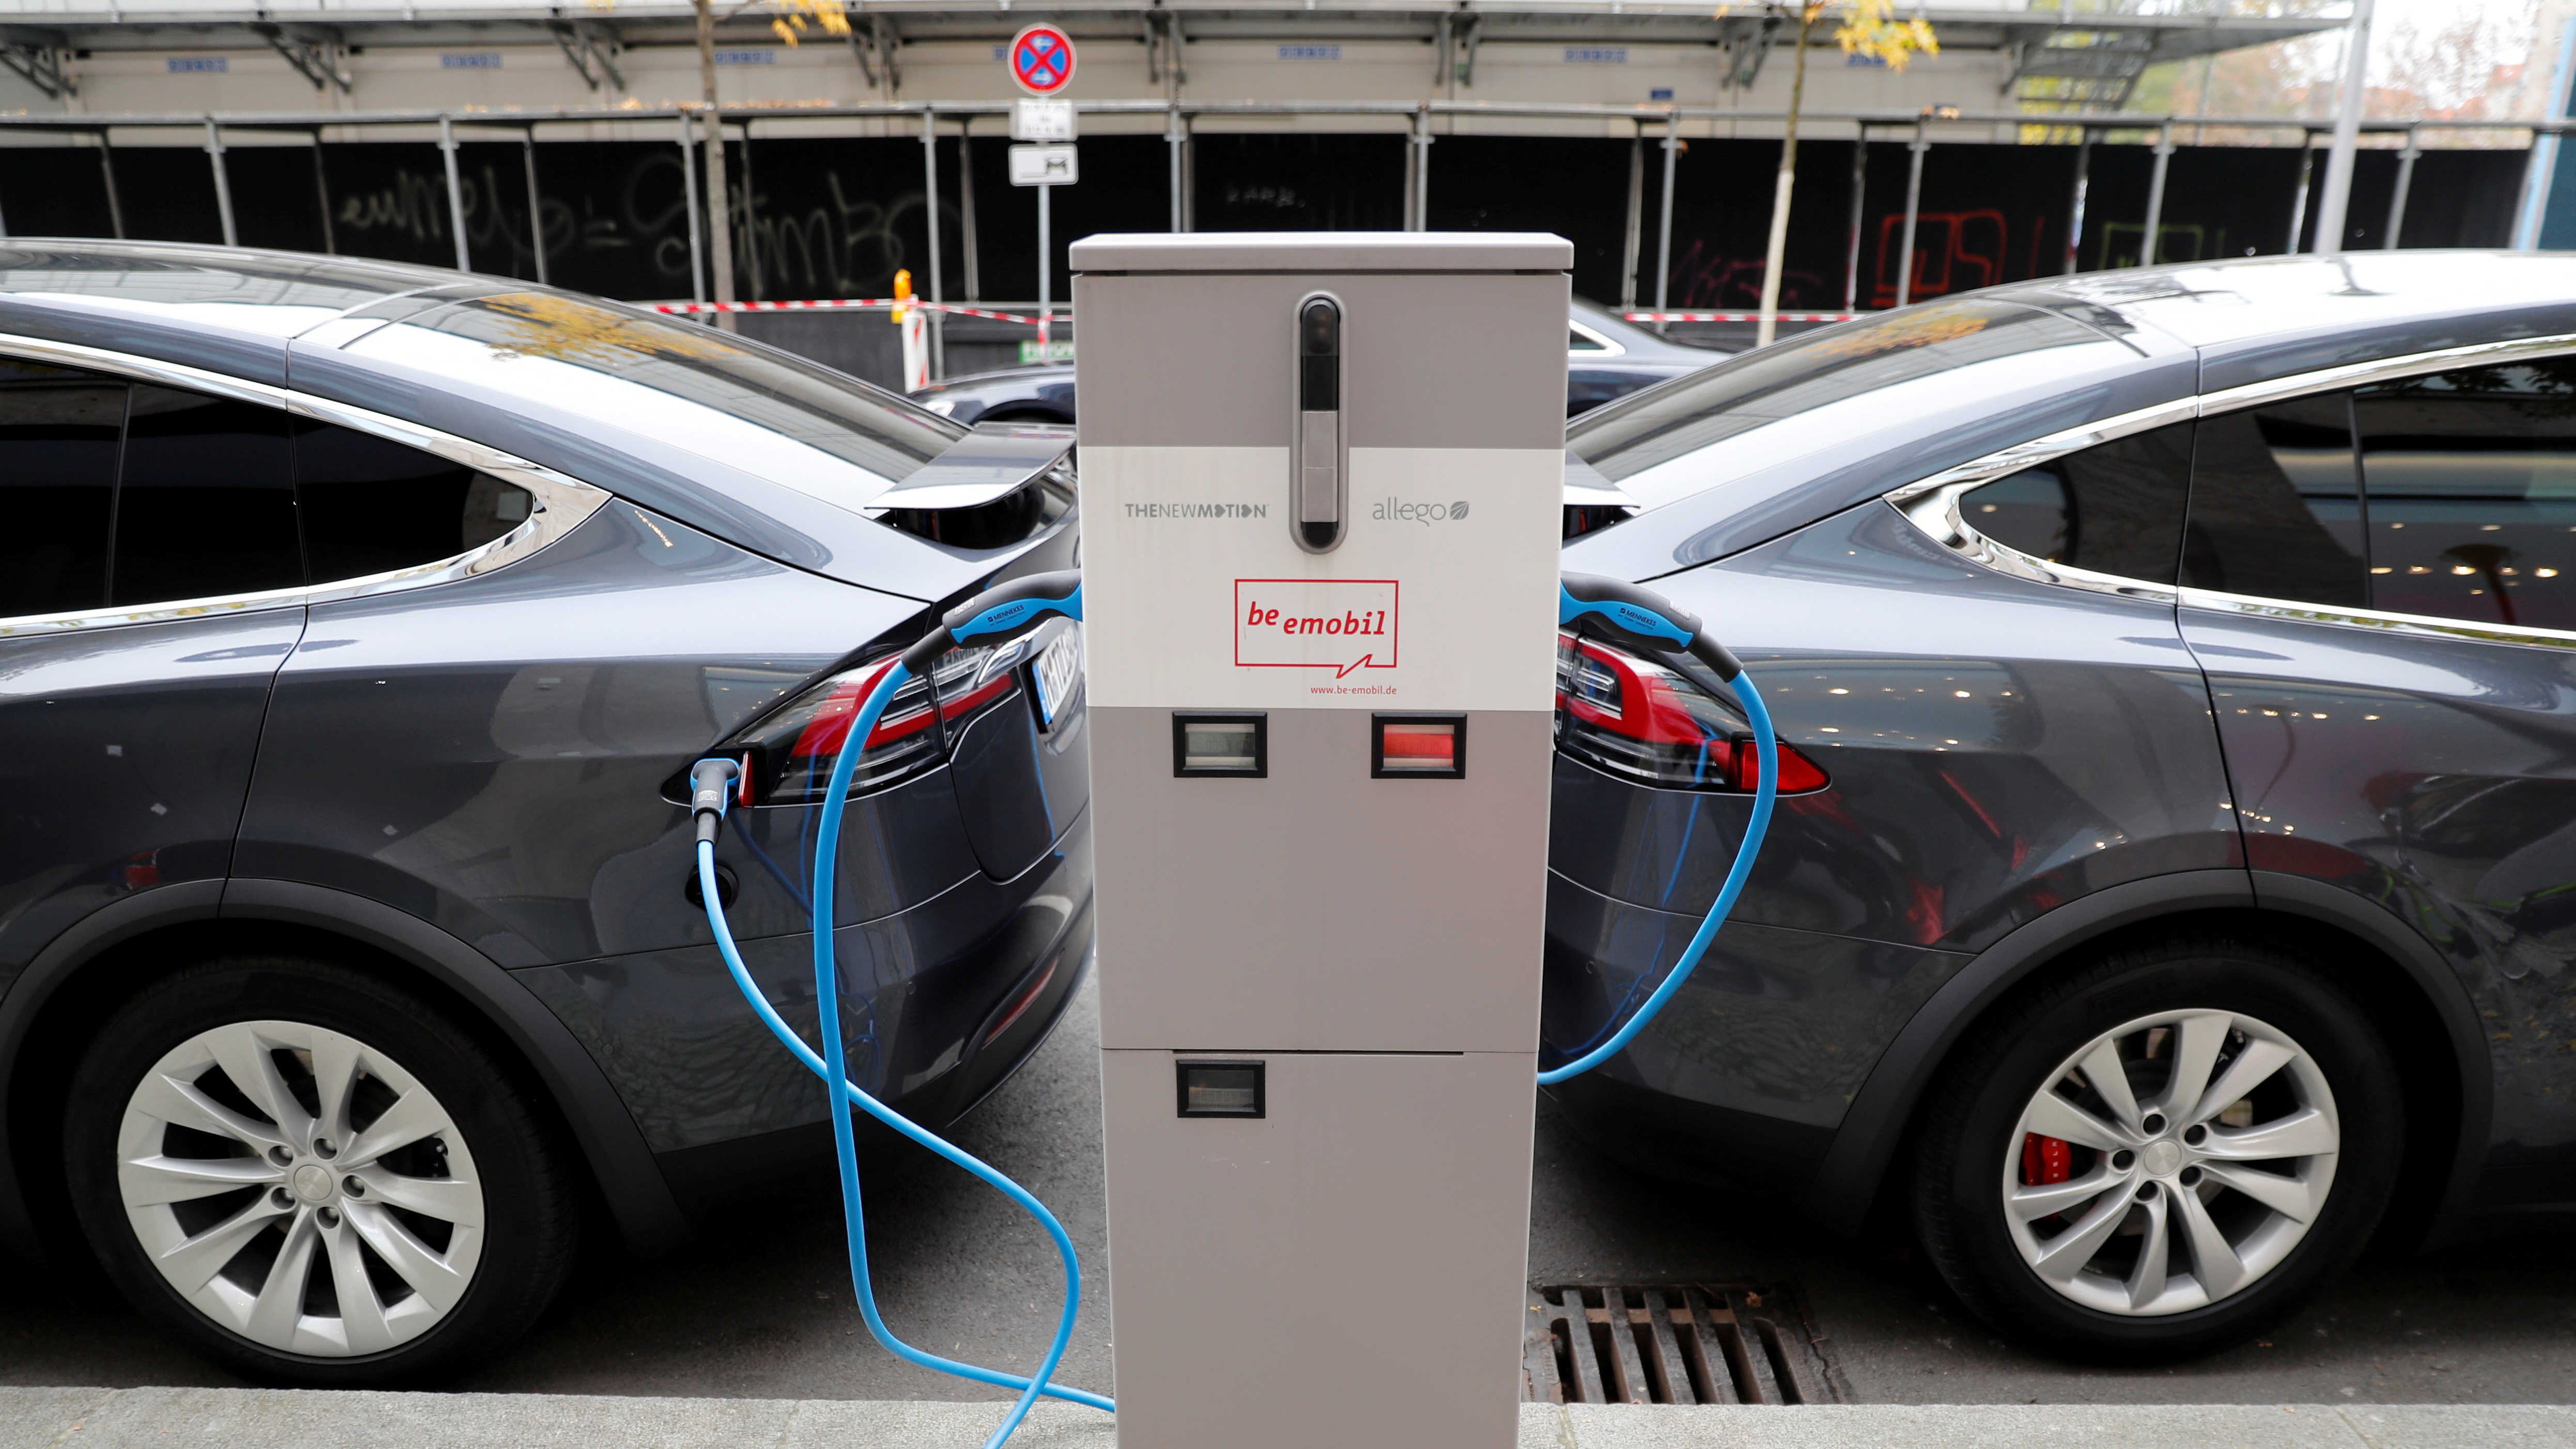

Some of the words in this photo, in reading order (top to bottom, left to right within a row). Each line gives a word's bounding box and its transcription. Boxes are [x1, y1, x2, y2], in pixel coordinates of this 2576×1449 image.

[1372, 497, 1446, 527] allego
[993, 604, 1024, 621] MENNEKES
[1247, 601, 1279, 626] be
[1284, 610, 1385, 635] emobil
[1626, 609, 1657, 626] MENNEKES
[1310, 685, 1397, 695] www.be-emobil.de
